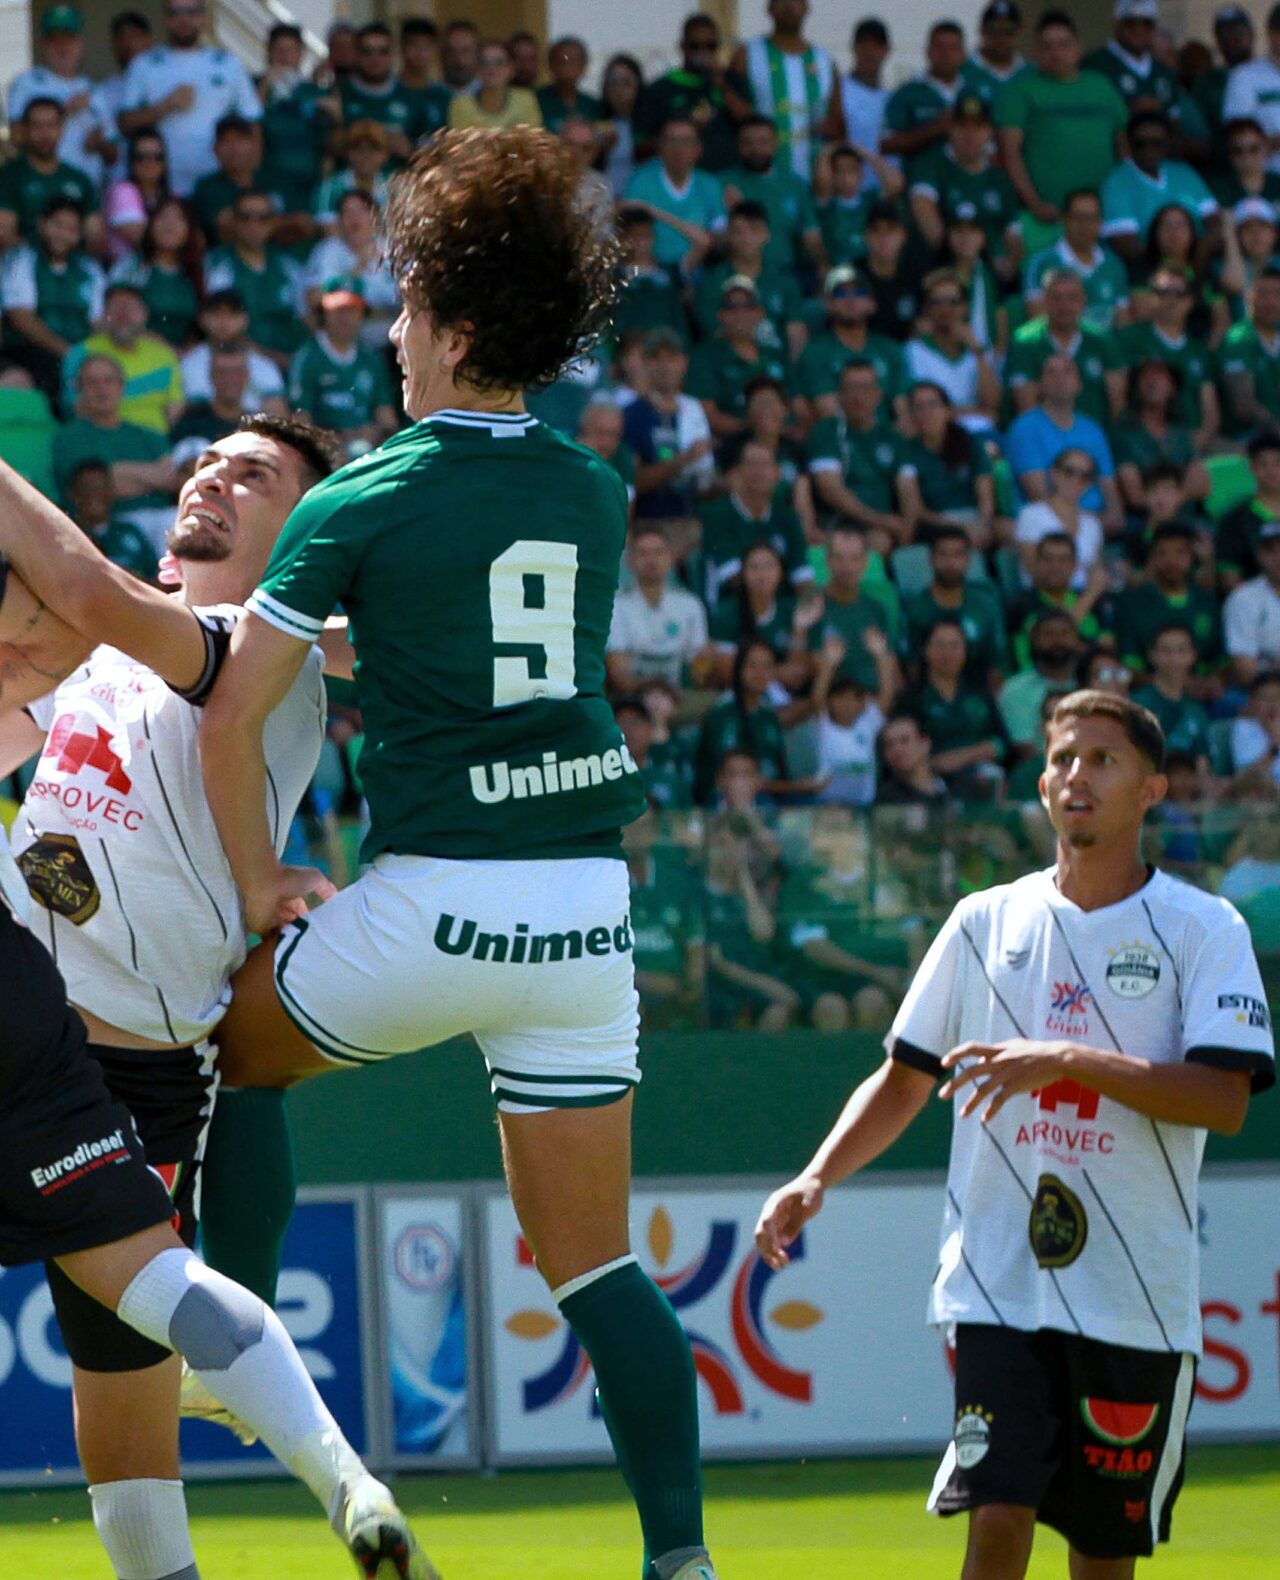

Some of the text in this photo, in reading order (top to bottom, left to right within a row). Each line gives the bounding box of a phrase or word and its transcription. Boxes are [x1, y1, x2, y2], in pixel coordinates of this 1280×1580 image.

[489, 540, 578, 707] 9
[434, 912, 634, 965] Unimed
[30, 1128, 125, 1188] Eurodiesel
